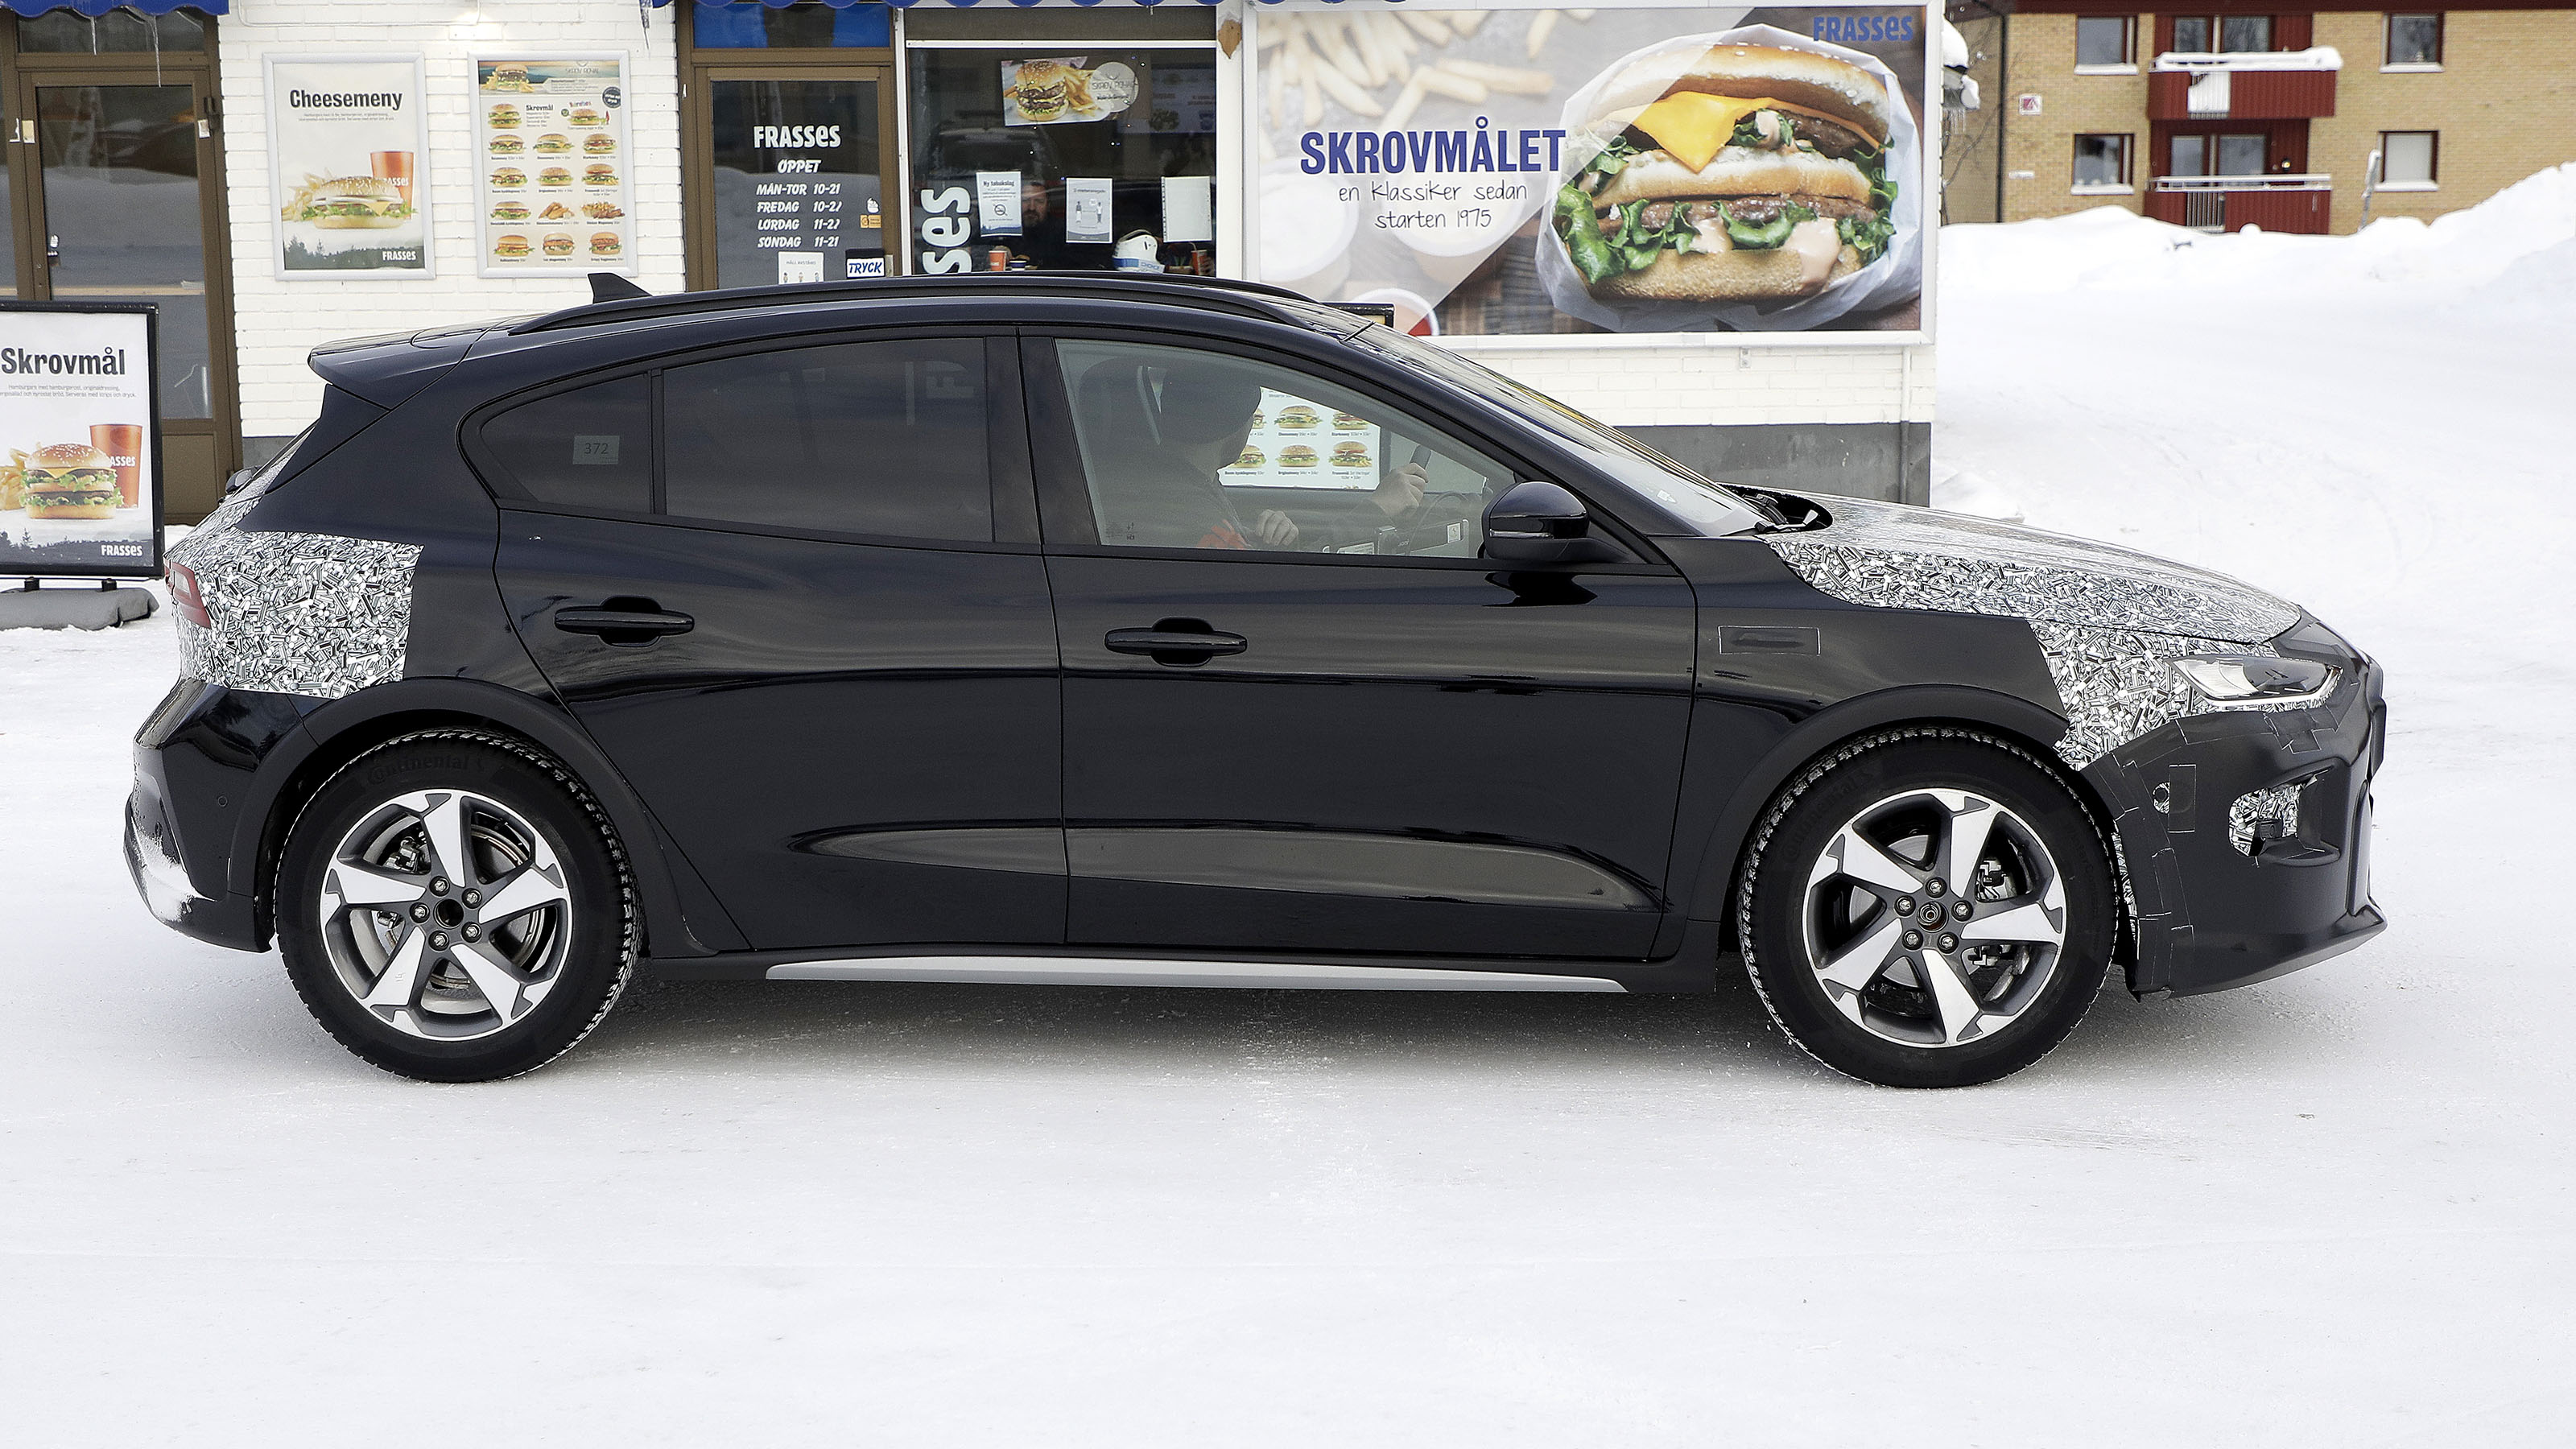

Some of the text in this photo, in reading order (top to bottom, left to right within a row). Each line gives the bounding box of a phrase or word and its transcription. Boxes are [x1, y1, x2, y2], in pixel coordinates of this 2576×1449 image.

[290, 89, 402, 110] Cheesemeny
[1300, 116, 1567, 175] SKROVMÅLET
[813, 183, 841, 195] 10-21
[1339, 185, 1360, 201] en
[1473, 179, 1528, 201] sedan
[757, 201, 800, 213] FREDAG
[1375, 208, 1492, 229] starten 1975
[814, 236, 840, 248] 11-21
[848, 262, 882, 274] TRYCK
[1, 346, 126, 375] Skrovmål
[584, 443, 609, 455] 372
